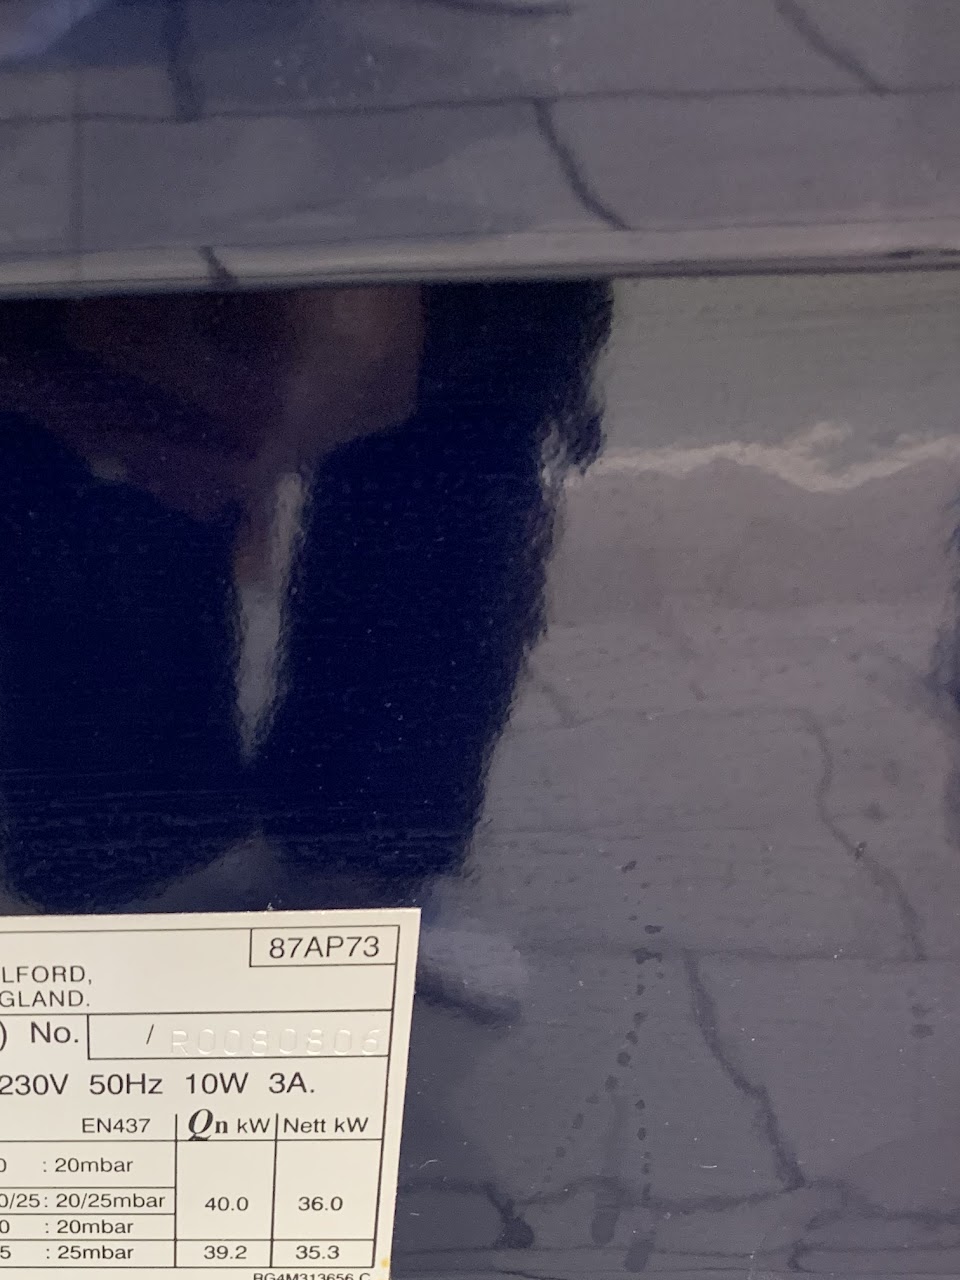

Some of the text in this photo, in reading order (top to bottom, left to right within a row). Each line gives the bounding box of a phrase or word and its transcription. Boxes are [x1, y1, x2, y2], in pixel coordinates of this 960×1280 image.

[268, 935, 380, 960] 87AP73
[30, 1020, 79, 1044] No.
[89, 1072, 164, 1096] 50Hz
[185, 1071, 249, 1095] 10W
[268, 1071, 315, 1095] 3A.
[81, 1117, 151, 1134] EN437
[187, 1108, 271, 1142] Qn kW
[283, 1116, 369, 1134] Nett kW
[54, 1157, 134, 1173] 20mbar
[55, 1192, 166, 1210] 20/25mbar
[204, 1196, 249, 1212] 40.0
[298, 1195, 344, 1212] 36.0
[56, 1218, 134, 1234] 20mbar
[57, 1244, 135, 1260] 25mbar
[203, 1244, 248, 1260] 39.2
[295, 1244, 340, 1260] 35.3
